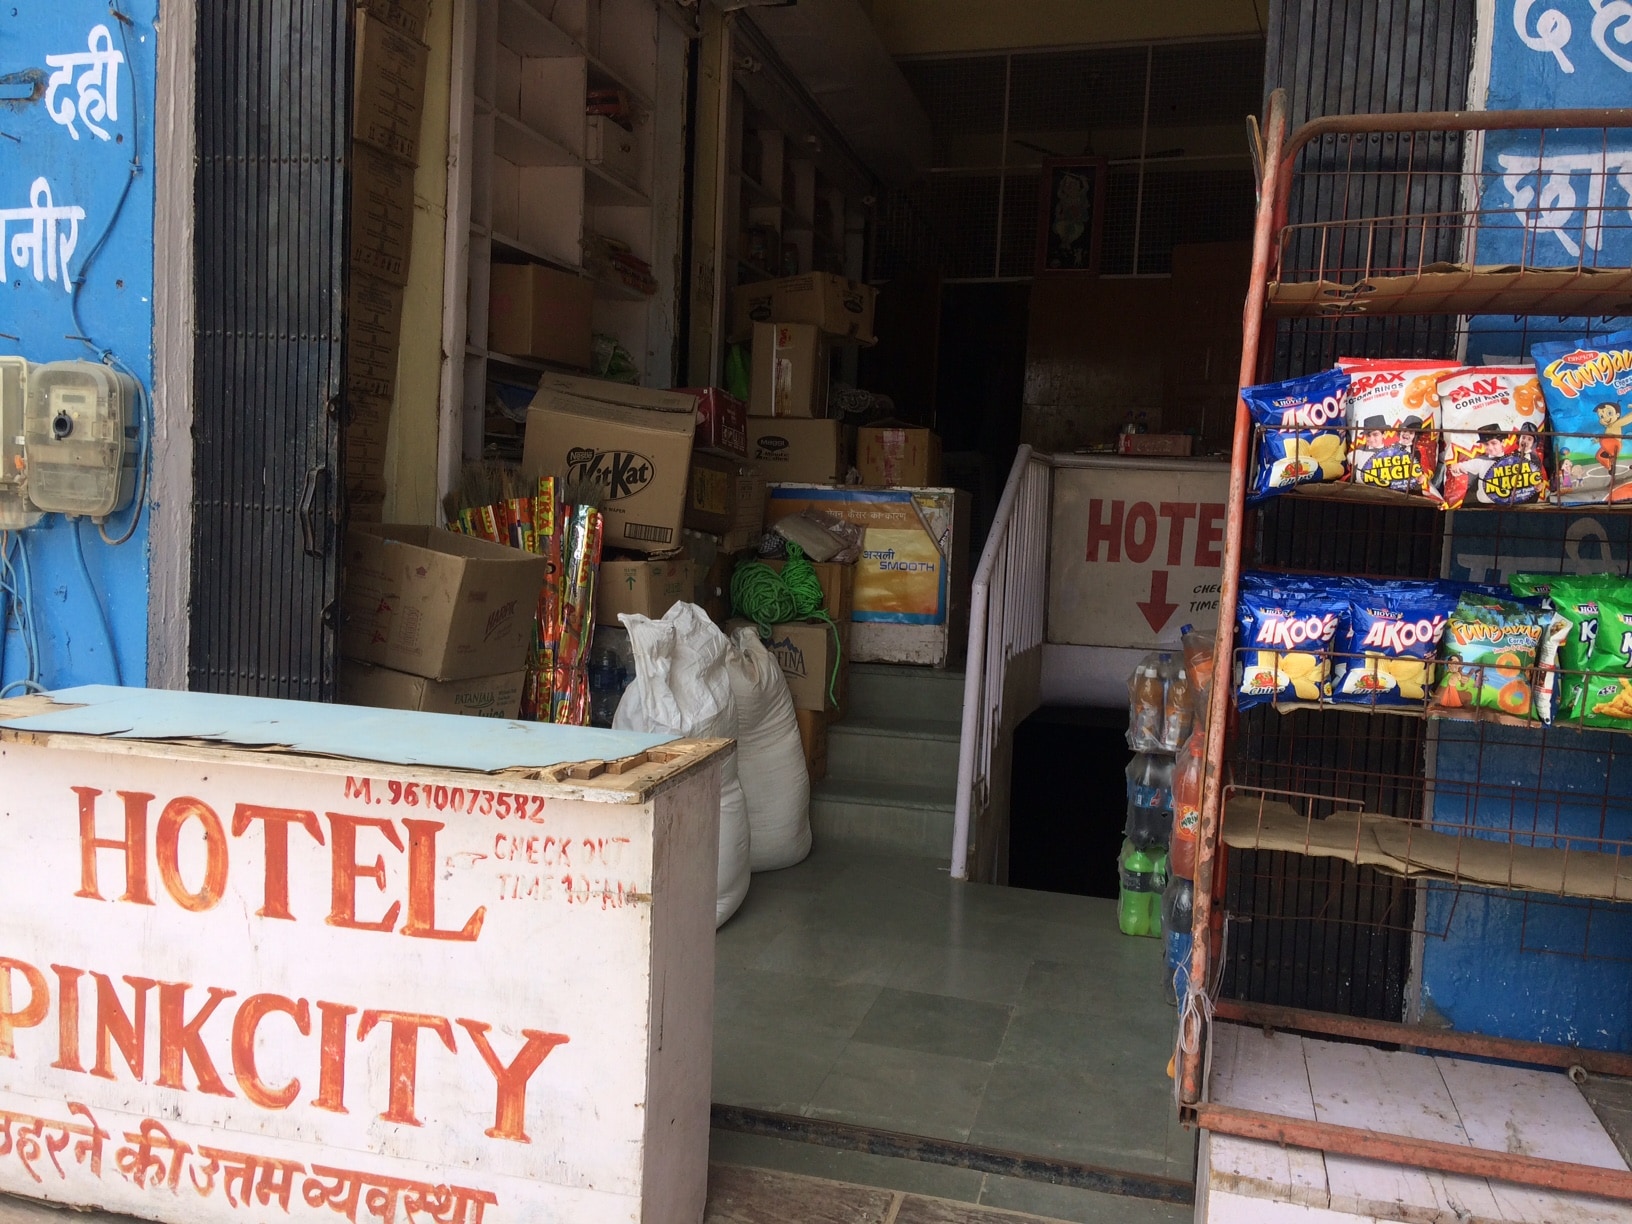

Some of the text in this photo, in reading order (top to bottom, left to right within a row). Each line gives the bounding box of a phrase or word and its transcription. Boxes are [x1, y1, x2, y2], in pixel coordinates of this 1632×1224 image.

[45, 24, 124, 141] दही
[1497, 151, 1632, 257] छा
[0, 176, 86, 293] नीर
[1374, 382, 1404, 395] RINGS
[1454, 396, 1482, 410] CORN
[578, 452, 649, 499] KitKat
[1364, 464, 1422, 487] MAGIC
[1372, 455, 1411, 469] MEGA
[1493, 461, 1531, 478] MEGA
[1485, 472, 1542, 498] MAGIC
[1085, 498, 1226, 568] HOTE
[862, 547, 895, 560] असली
[879, 561, 935, 573] SMOOTH
[1188, 600, 1219, 613] TIME
[1256, 612, 1339, 650] AKOO'S
[1362, 613, 1448, 655] AKOO'S
[454, 690, 496, 705] PATANJALI
[70, 785, 488, 942] HOTEL
[494, 832, 631, 867] CHECK OUT
[496, 873, 555, 901] TIME
[0, 956, 571, 1144] PINKCITY
[115, 1118, 194, 1196] की
[189, 1144, 306, 1215] उत्तम
